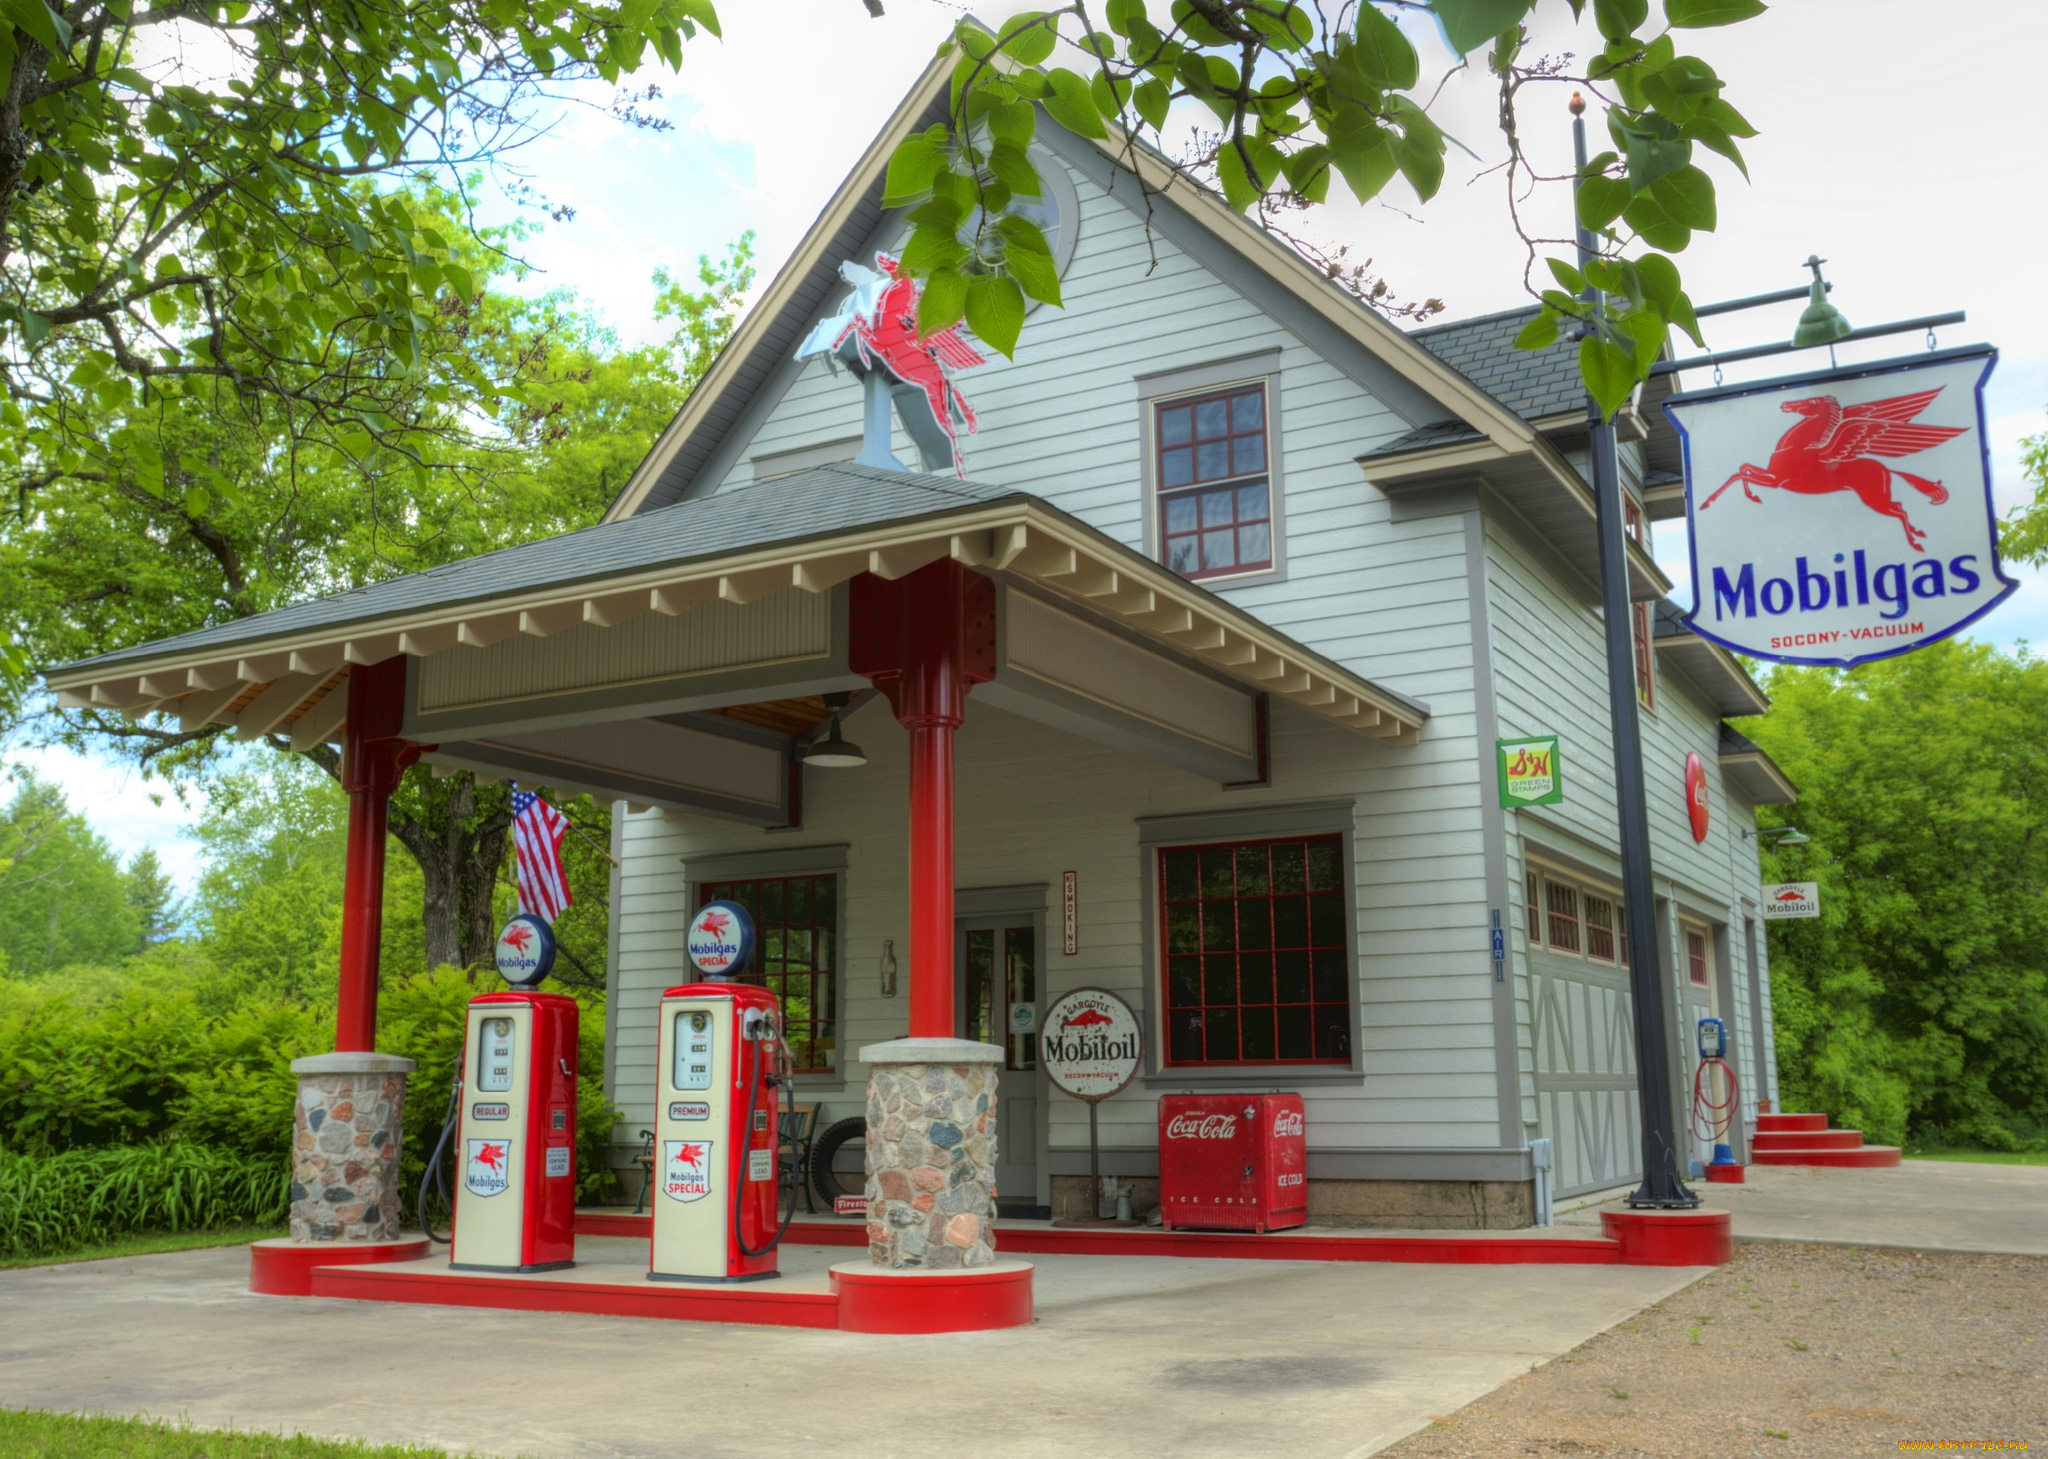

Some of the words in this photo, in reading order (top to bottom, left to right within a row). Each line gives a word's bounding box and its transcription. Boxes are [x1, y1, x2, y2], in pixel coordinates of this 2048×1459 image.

[1712, 549, 1981, 620] Mobilgas
[1770, 622, 1925, 649] SOCONY-VACUUM
[1511, 778, 1551, 787] GREEN
[1511, 784, 1551, 794] STAMPS
[1767, 901, 1815, 913] Mobiloil
[1066, 884, 1074, 953] SMOKING
[690, 943, 737, 957] Mobilgas
[1494, 930, 1503, 959] AIR
[498, 956, 537, 970] Mobilgas
[699, 956, 729, 967] SPECIAL
[1067, 1000, 1110, 1015] GARGOYLE
[1045, 1032, 1136, 1062] Mobiloil
[476, 1106, 508, 1116] REGULAR
[673, 1106, 707, 1116] PREMIUM
[468, 1175, 505, 1191] Mobilgas
[670, 1172, 704, 1183] Mobilgas
[1278, 1174, 1288, 1186] ICE
[1288, 1173, 1303, 1185] COLD
[668, 1183, 705, 1194] SPECIAL
